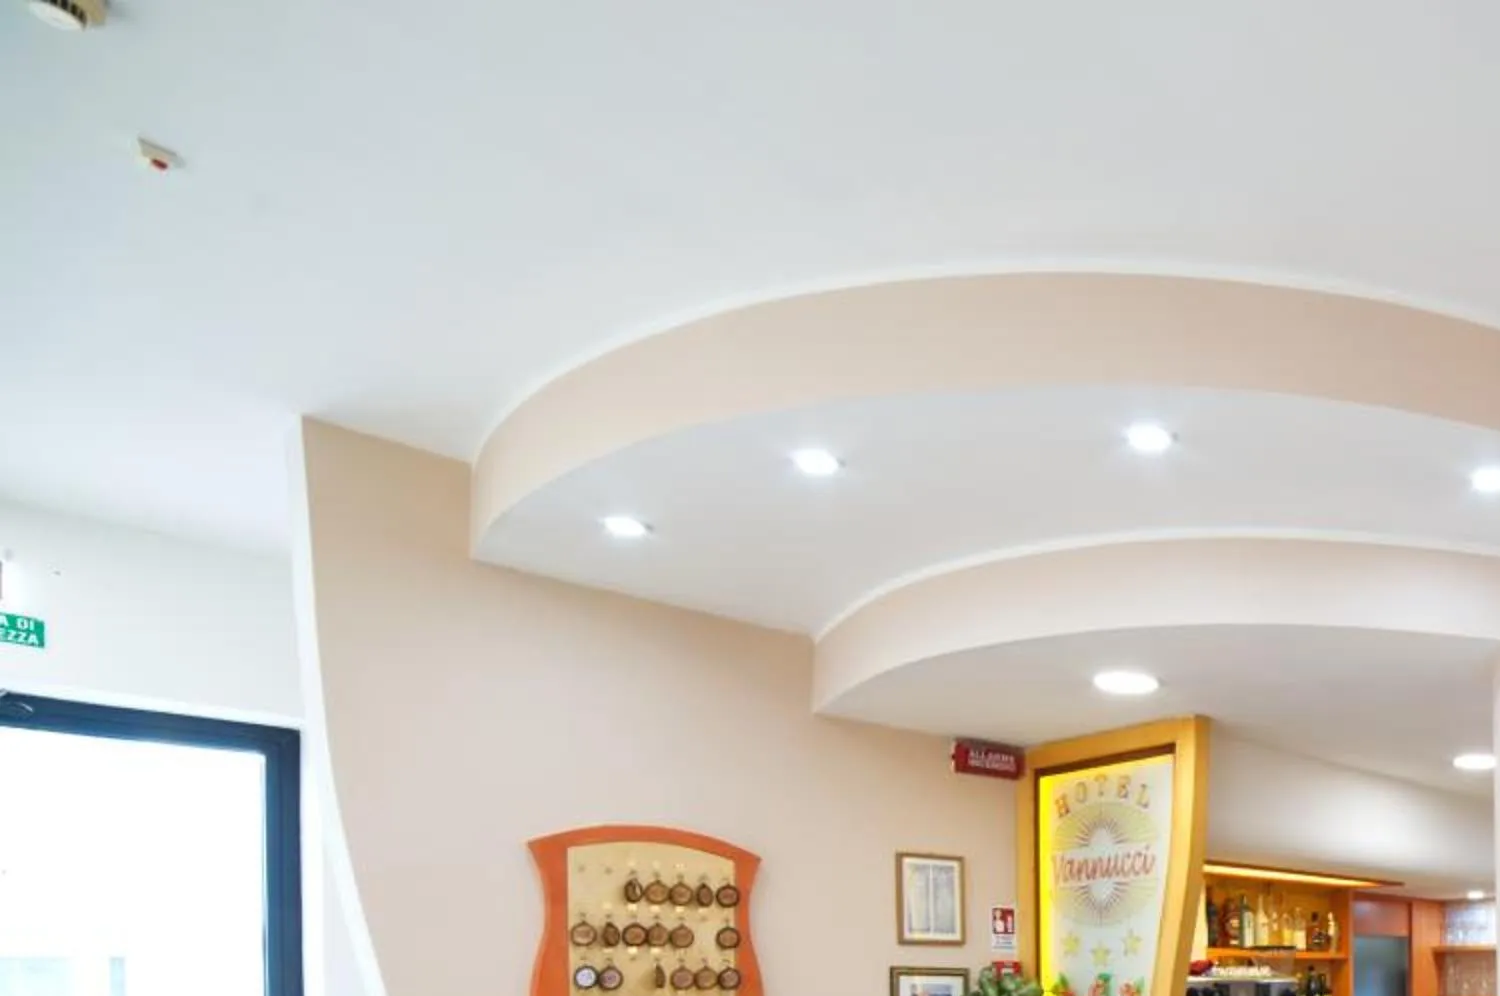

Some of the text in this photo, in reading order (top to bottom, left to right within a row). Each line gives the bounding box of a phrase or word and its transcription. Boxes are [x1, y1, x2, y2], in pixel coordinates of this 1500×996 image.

[16, 617, 35, 631] DI
[1055, 773, 1150, 818] HOTEL
[1053, 844, 1156, 883] Vannucci
